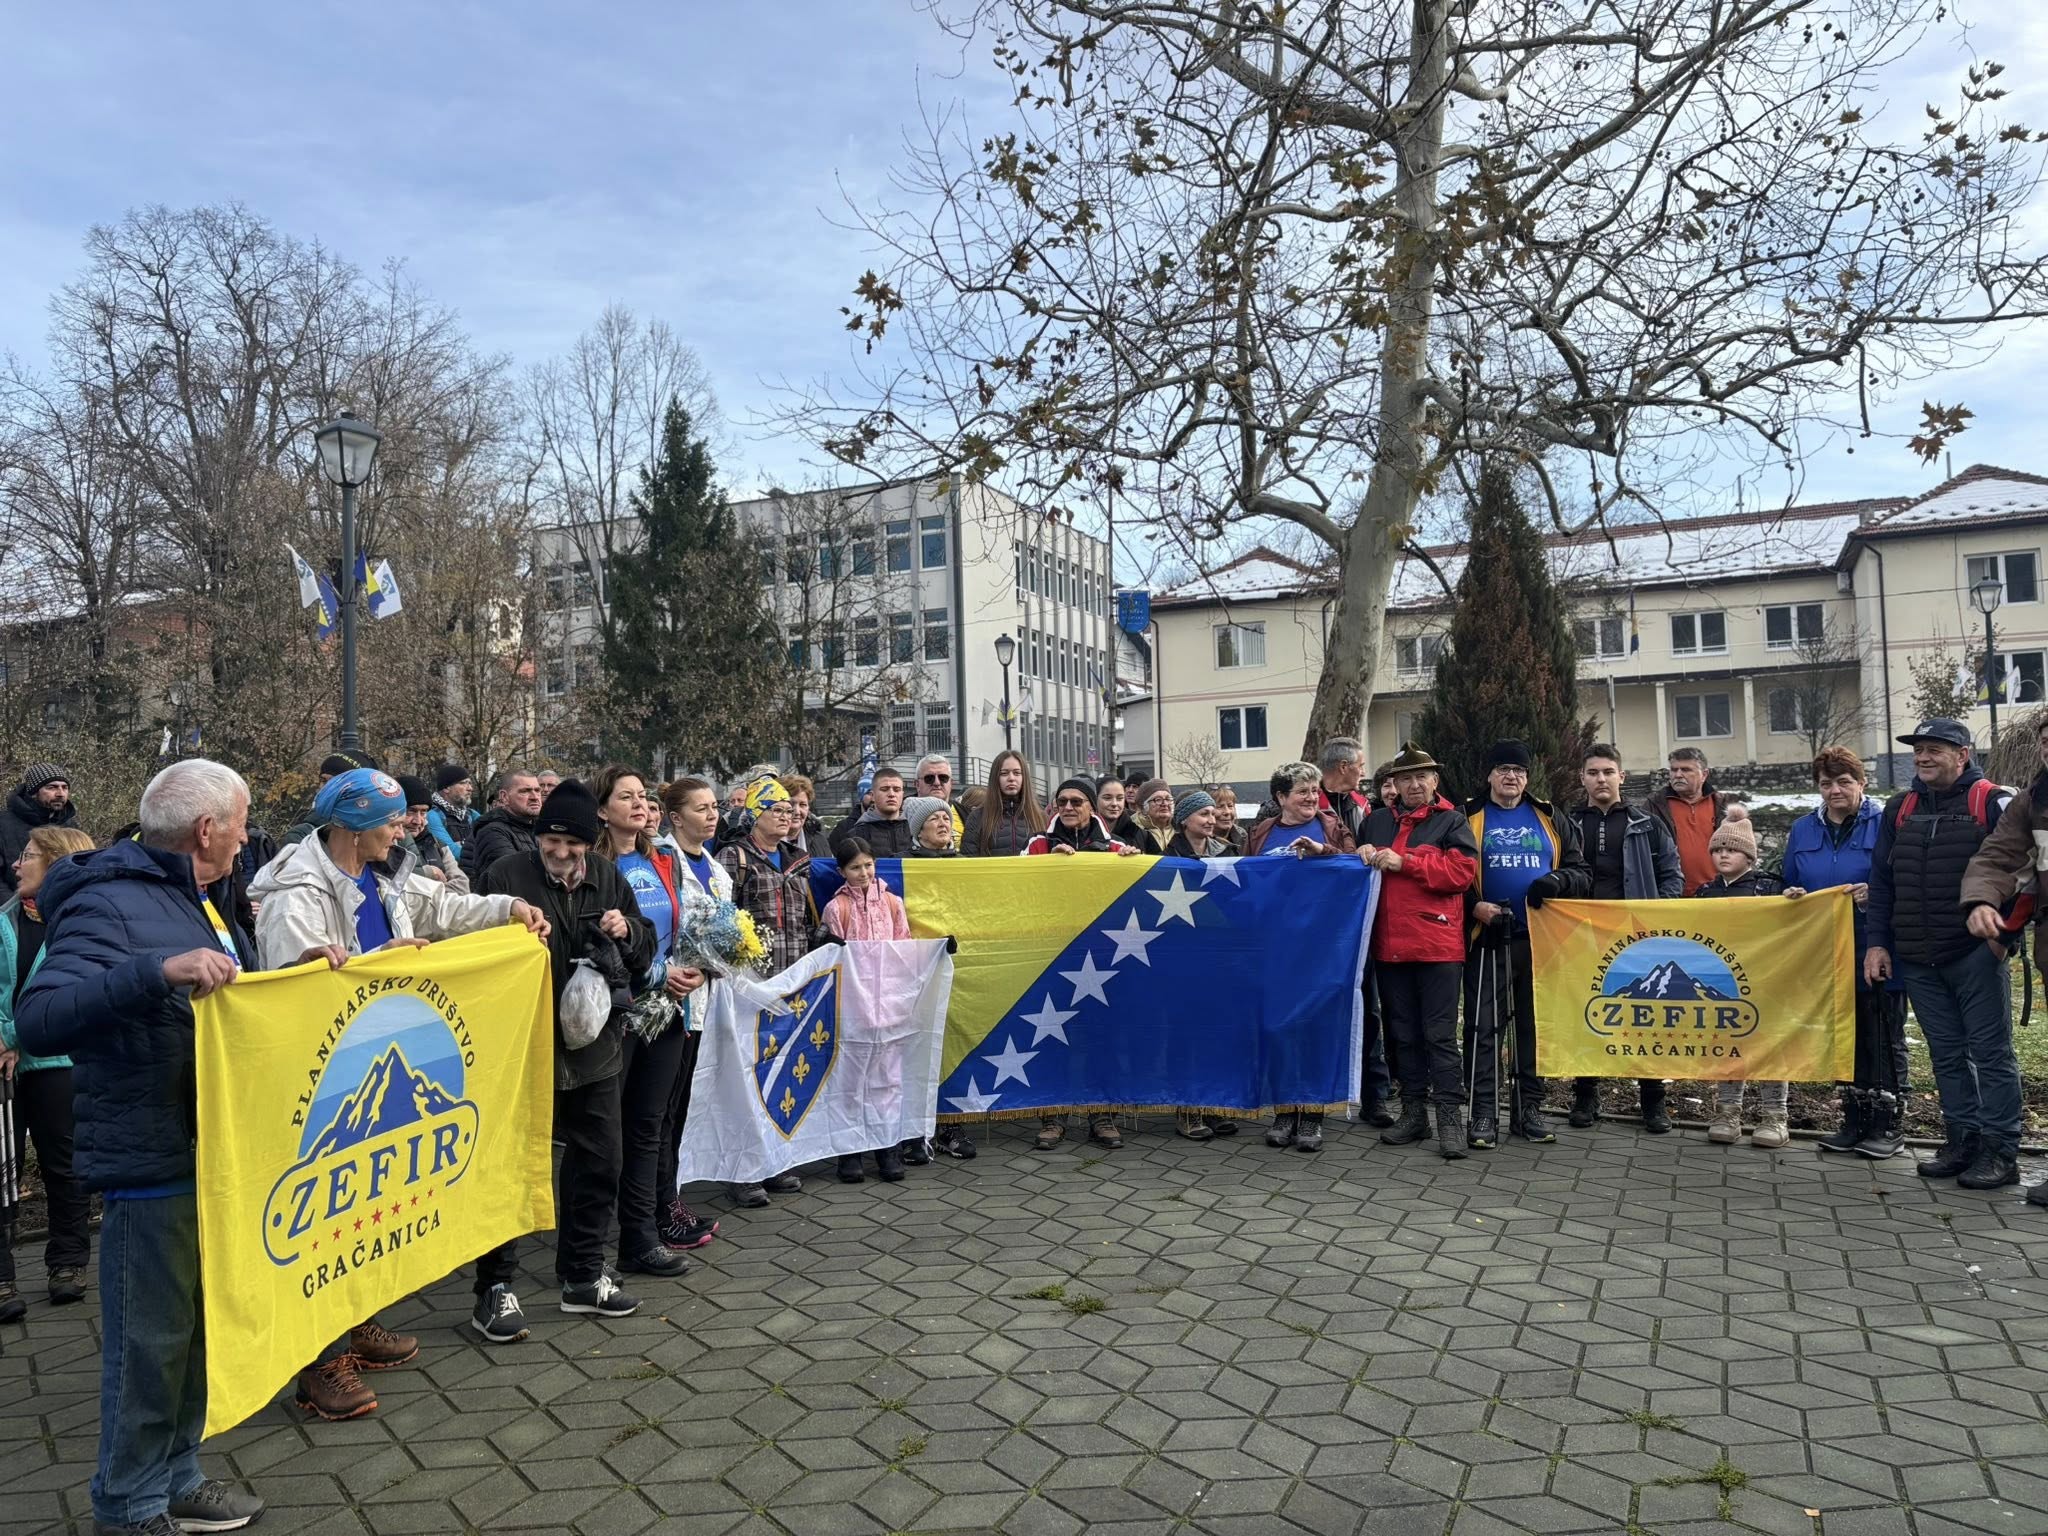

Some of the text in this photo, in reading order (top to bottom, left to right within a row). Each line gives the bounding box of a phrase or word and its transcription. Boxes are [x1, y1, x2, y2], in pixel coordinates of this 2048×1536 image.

[1488, 855, 1541, 868] ZEFIR
[1591, 929, 1752, 996] PLANINARSKO DRUŠTVO
[1602, 1003, 1742, 1029] ZEFIR
[291, 976, 475, 1128] PLANINARSKO DRUŠTVO
[1606, 1042, 1742, 1058] GRAČANICA
[286, 1122, 461, 1240] ZEFIR
[301, 1208, 442, 1299] GRAČANICA
